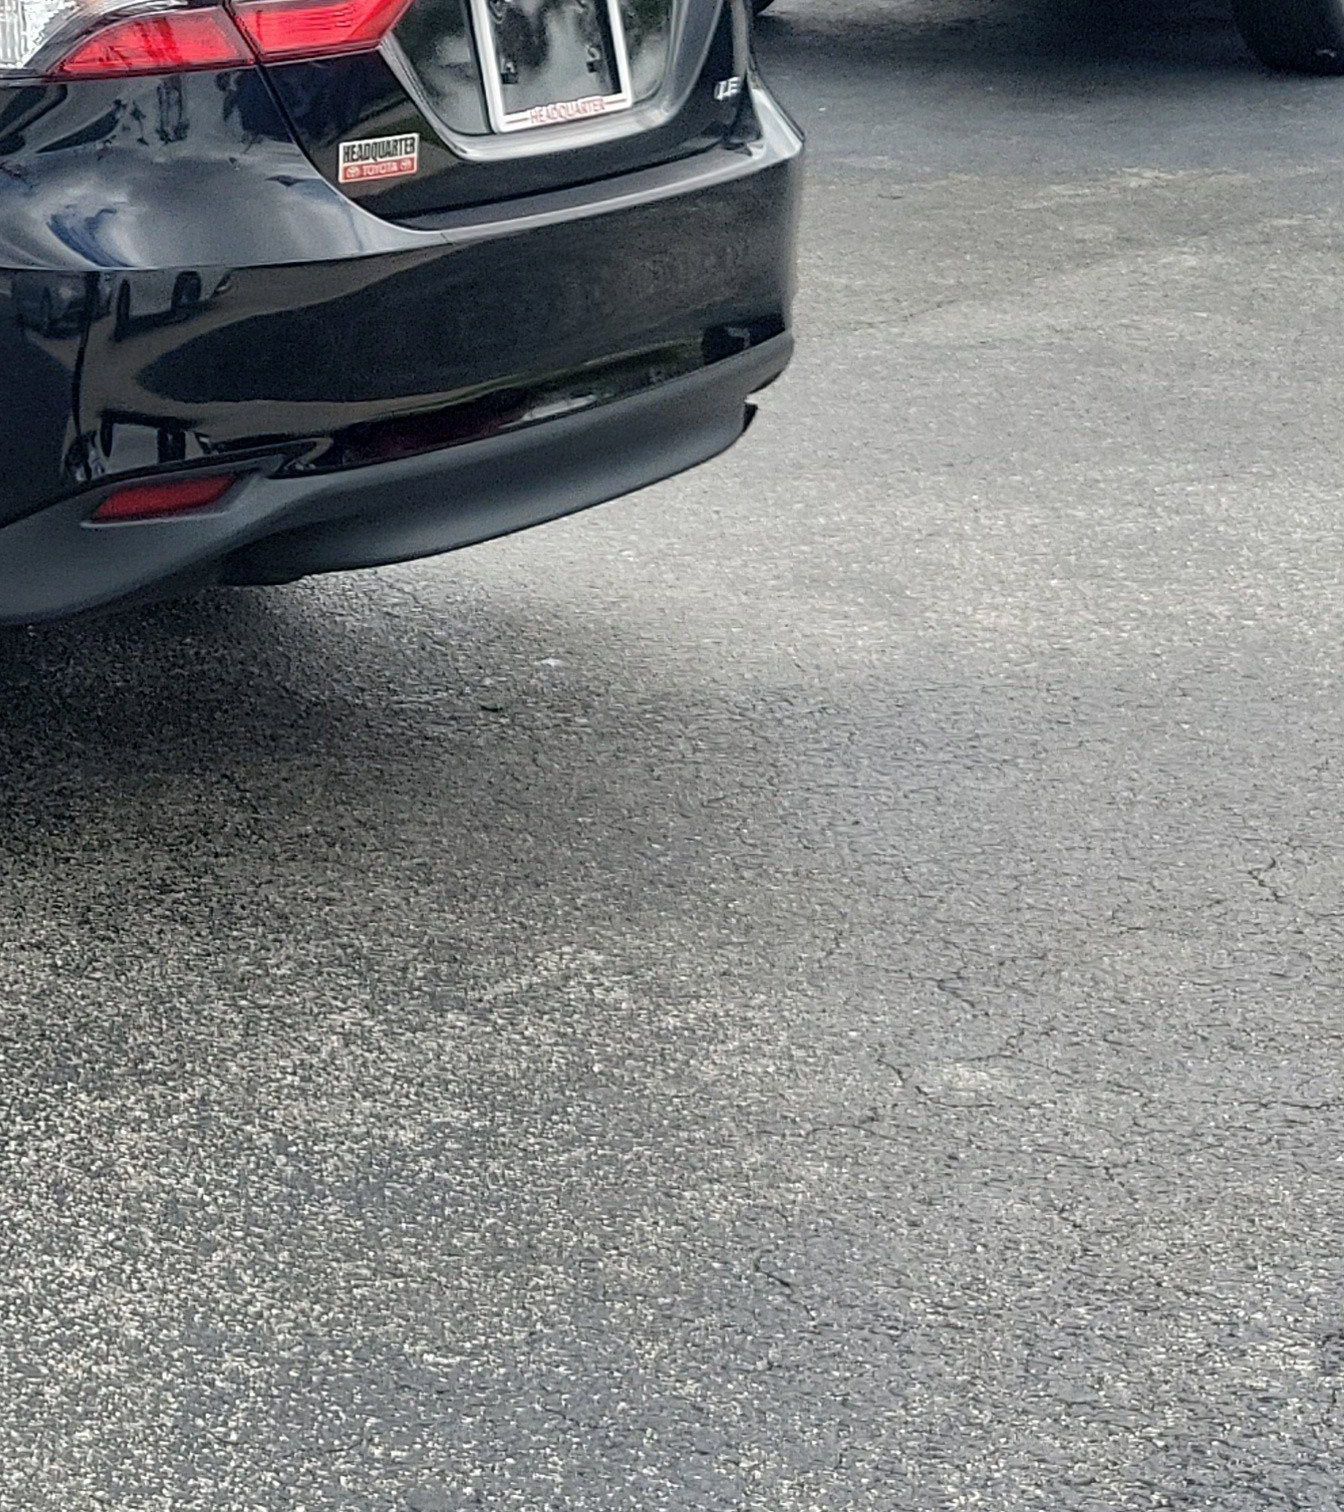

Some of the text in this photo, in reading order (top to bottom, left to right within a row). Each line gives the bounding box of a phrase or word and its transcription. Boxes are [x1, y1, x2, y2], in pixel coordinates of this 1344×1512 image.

[530, 97, 606, 124] HEADQUARTER
[343, 137, 415, 163] HEADQUARTER
[362, 160, 399, 177] TOYOTA
